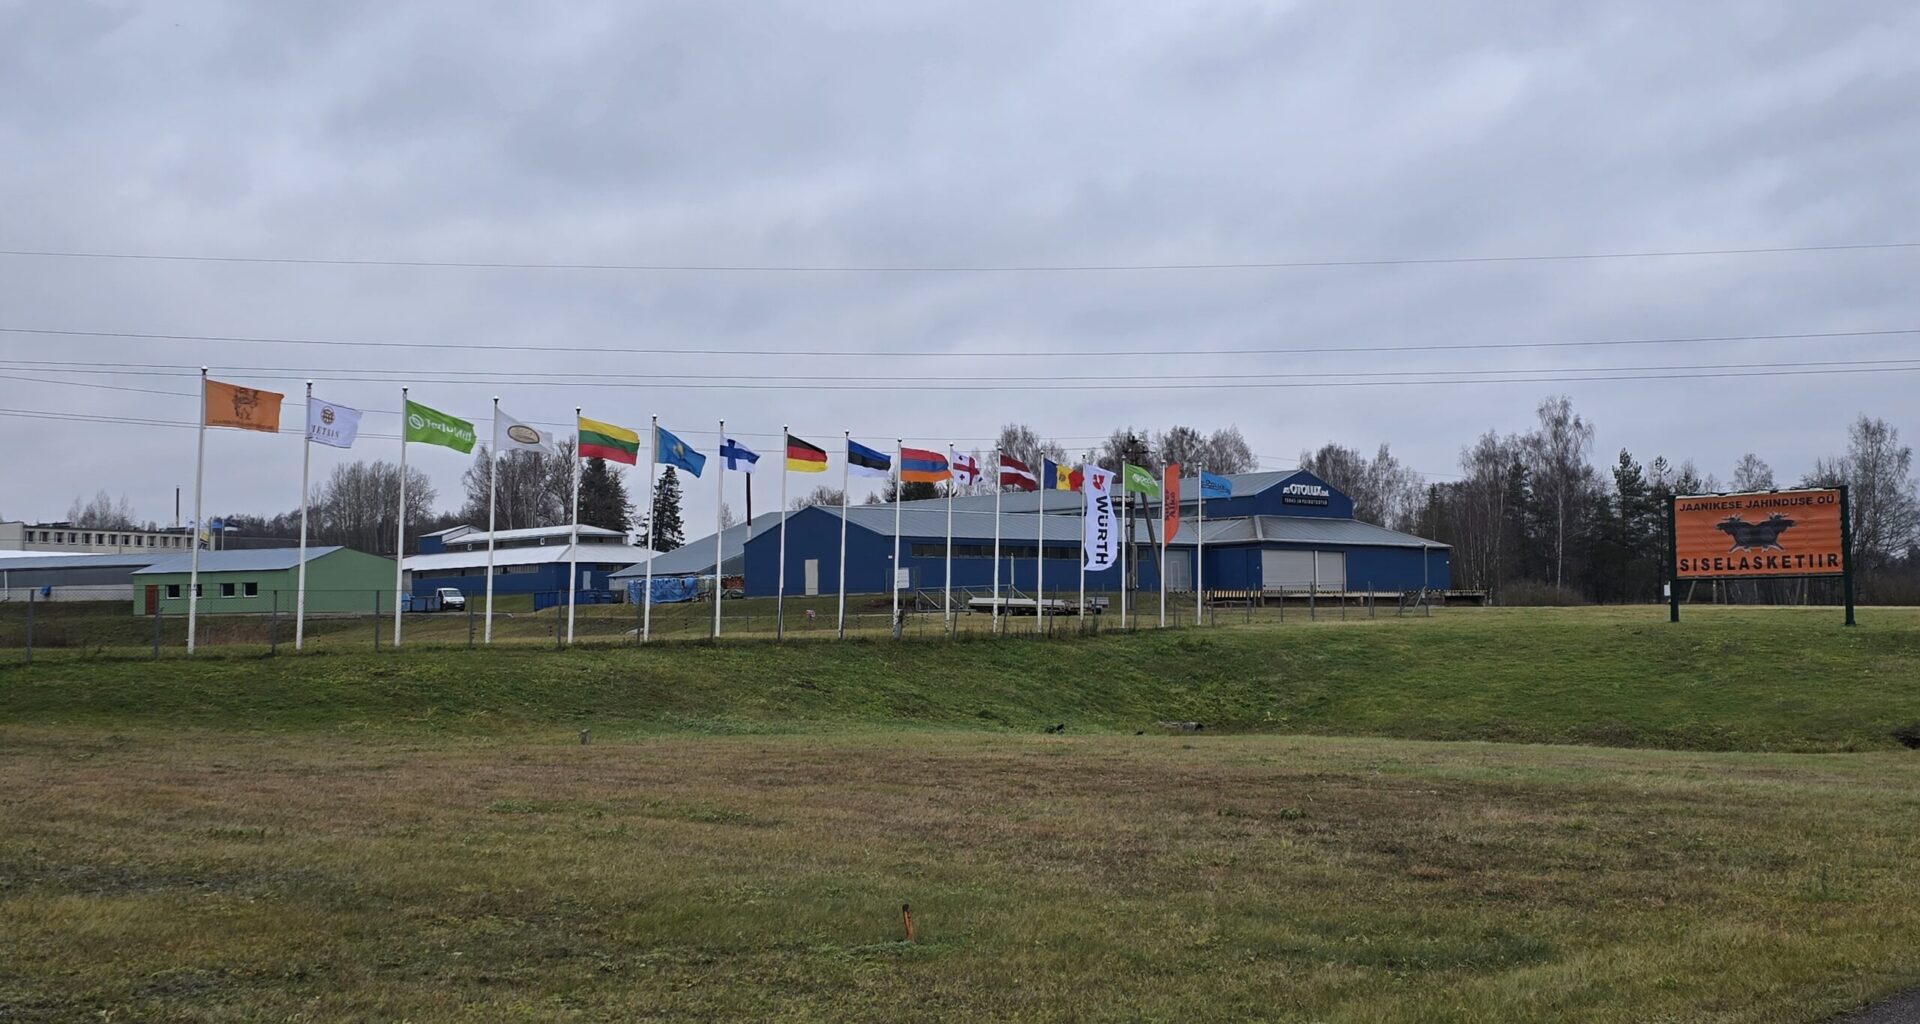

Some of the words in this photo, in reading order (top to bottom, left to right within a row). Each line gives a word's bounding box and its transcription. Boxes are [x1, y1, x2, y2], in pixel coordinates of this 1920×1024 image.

[1290, 484, 1321, 496] OTOLUX
[1680, 501, 1742, 512] JAANIKESE
[1746, 497, 1813, 509] JAHINDUSE
[1817, 495, 1835, 504] OÜ
[1095, 496, 1109, 564] WÜRTH
[1680, 554, 1838, 571] SISELASKETIIR
